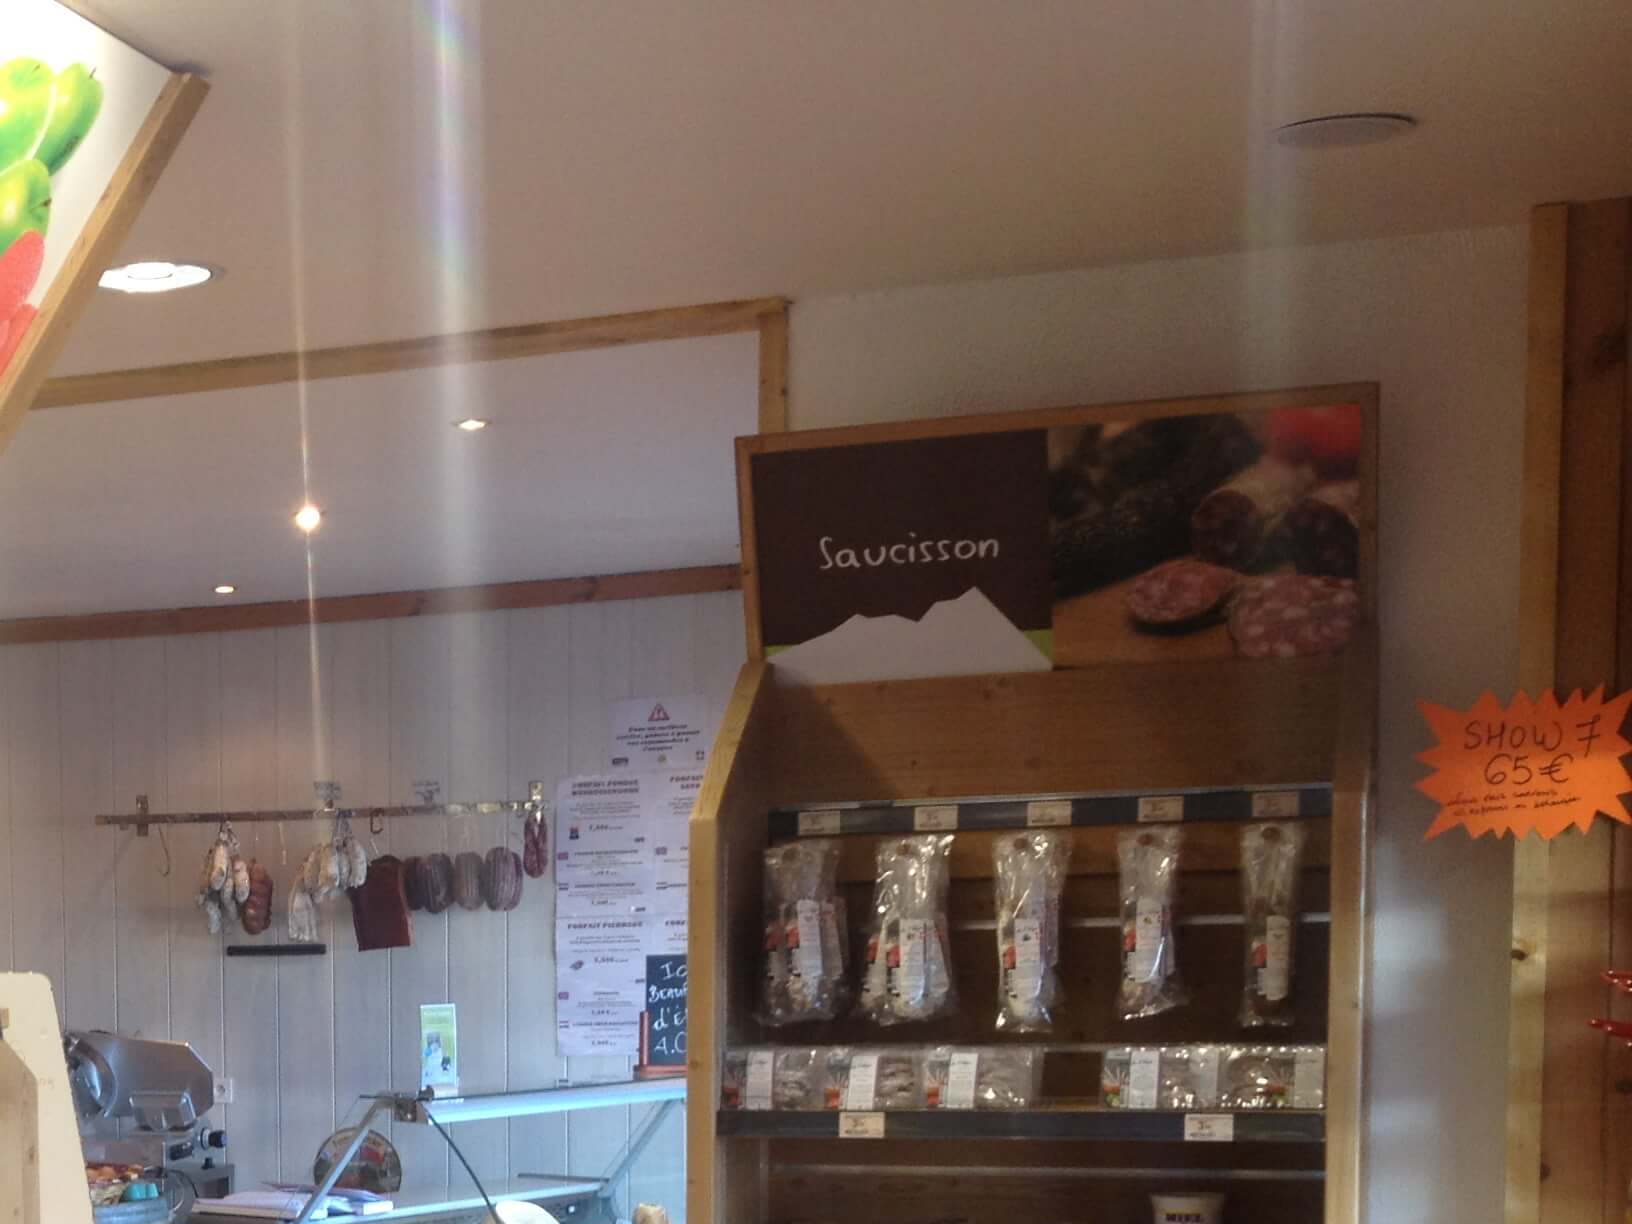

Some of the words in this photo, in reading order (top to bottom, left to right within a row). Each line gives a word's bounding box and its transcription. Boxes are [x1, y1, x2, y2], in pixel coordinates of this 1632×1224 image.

[818, 531, 1000, 570] Saucisson
[1464, 720, 1563, 751] SHOW
[1576, 715, 1601, 758] 7
[1166, 1213, 1204, 1222] MIEL
